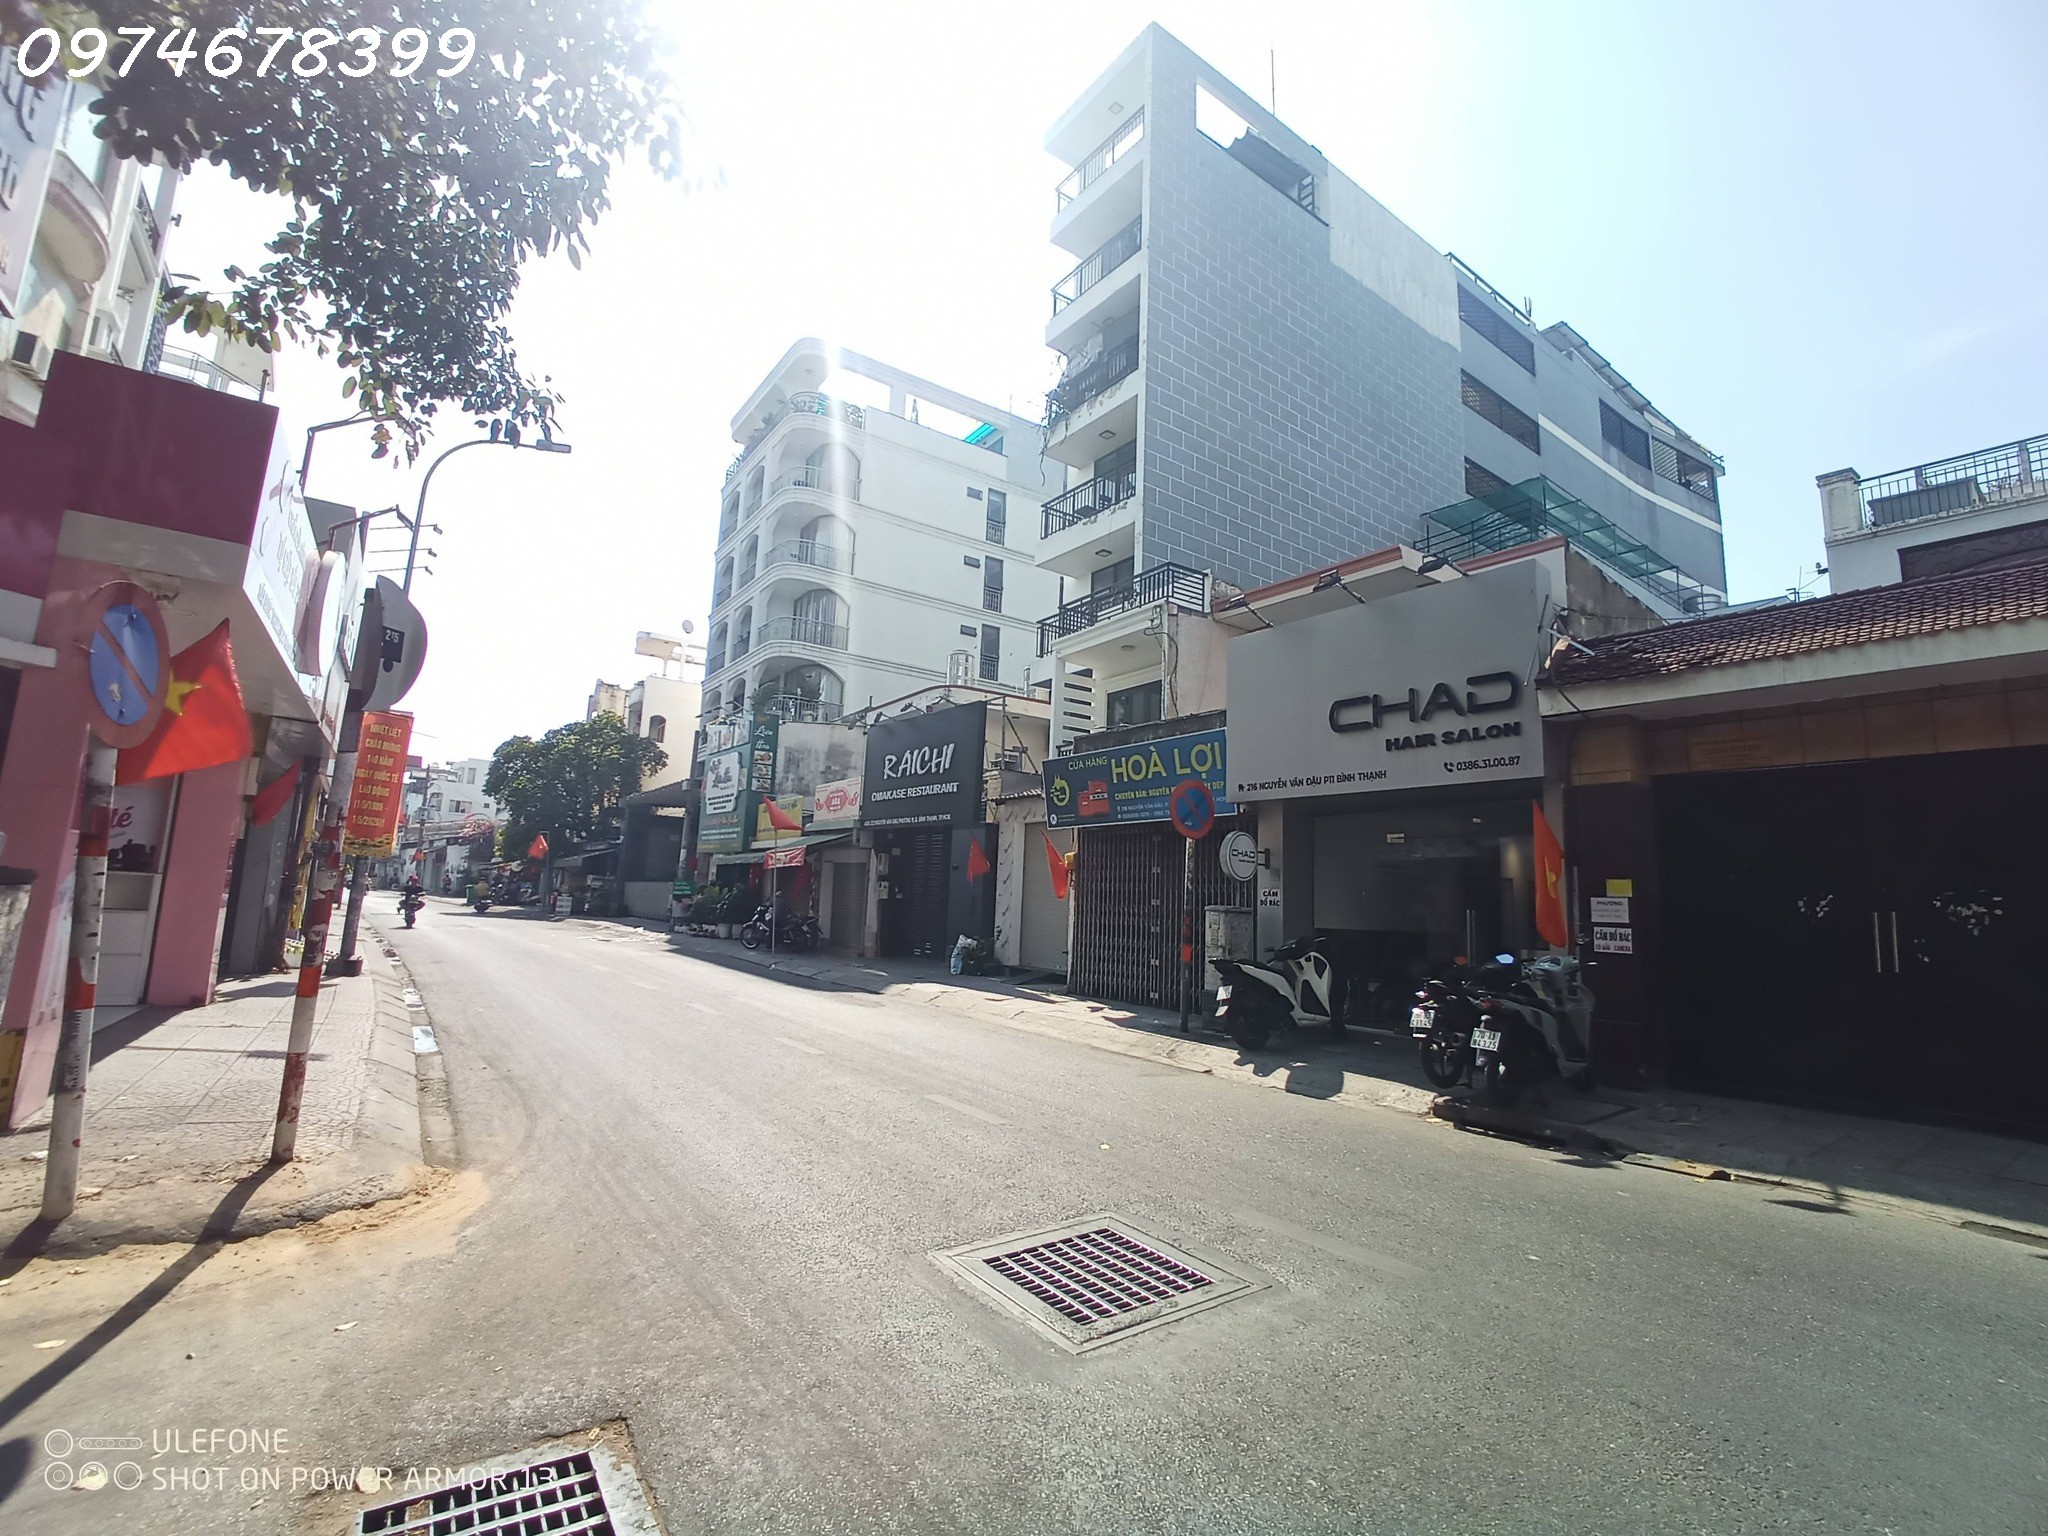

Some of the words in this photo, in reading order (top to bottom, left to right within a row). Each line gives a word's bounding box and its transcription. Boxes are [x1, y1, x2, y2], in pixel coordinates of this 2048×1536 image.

[1328, 670, 1521, 733] CHAD
[1385, 733, 1437, 752] HAIR
[1441, 721, 1522, 745] SALON
[883, 742, 954, 779] RAICHI
[1085, 755, 1108, 768] HÀNG
[1111, 746, 1167, 784] HOÀ
[1173, 742, 1222, 779] LỢI
[1456, 755, 1520, 772] 0386.31.00.87
[871, 788, 907, 801] OMAKASE
[907, 782, 959, 797] RESTAURANT
[1246, 782, 1258, 792] 216
[1259, 776, 1287, 790] NGUYỄN
[1336, 770, 1355, 784] BÌNH
[1231, 849, 1255, 858] CHAD
